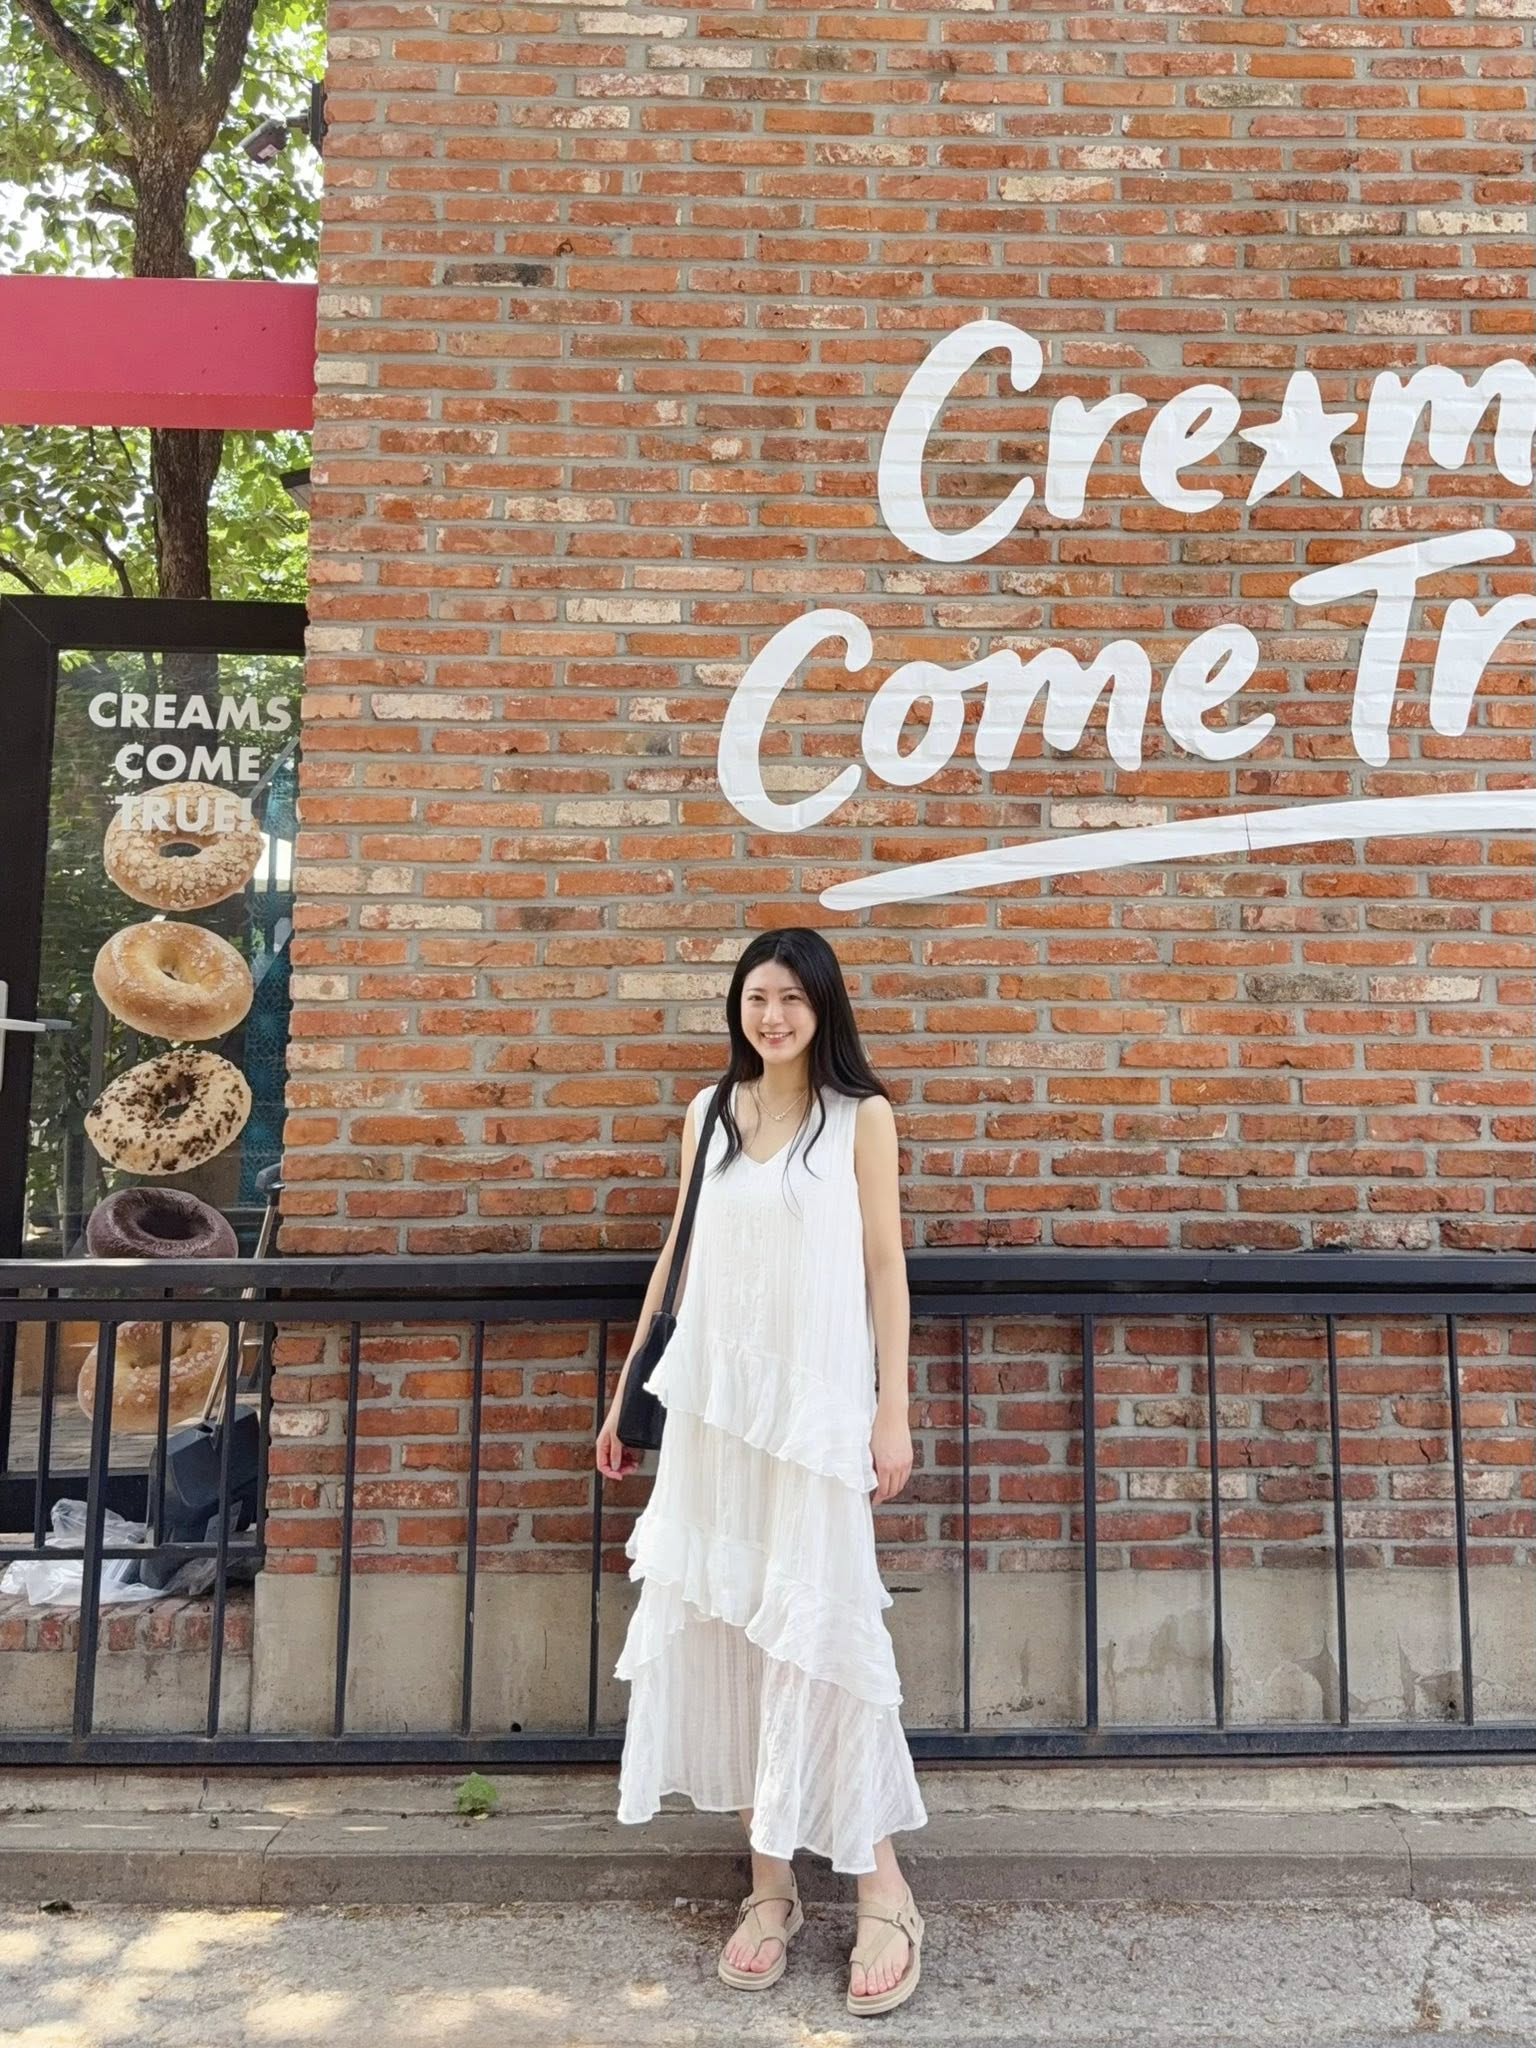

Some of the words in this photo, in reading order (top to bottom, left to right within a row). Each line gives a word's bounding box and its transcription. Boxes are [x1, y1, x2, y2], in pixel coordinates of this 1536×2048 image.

[718, 608, 1276, 833] Come
[1289, 529, 1536, 767] Tr
[88, 692, 292, 732] CREAMS
[115, 743, 261, 782] COME
[115, 795, 253, 833] TRUE!
